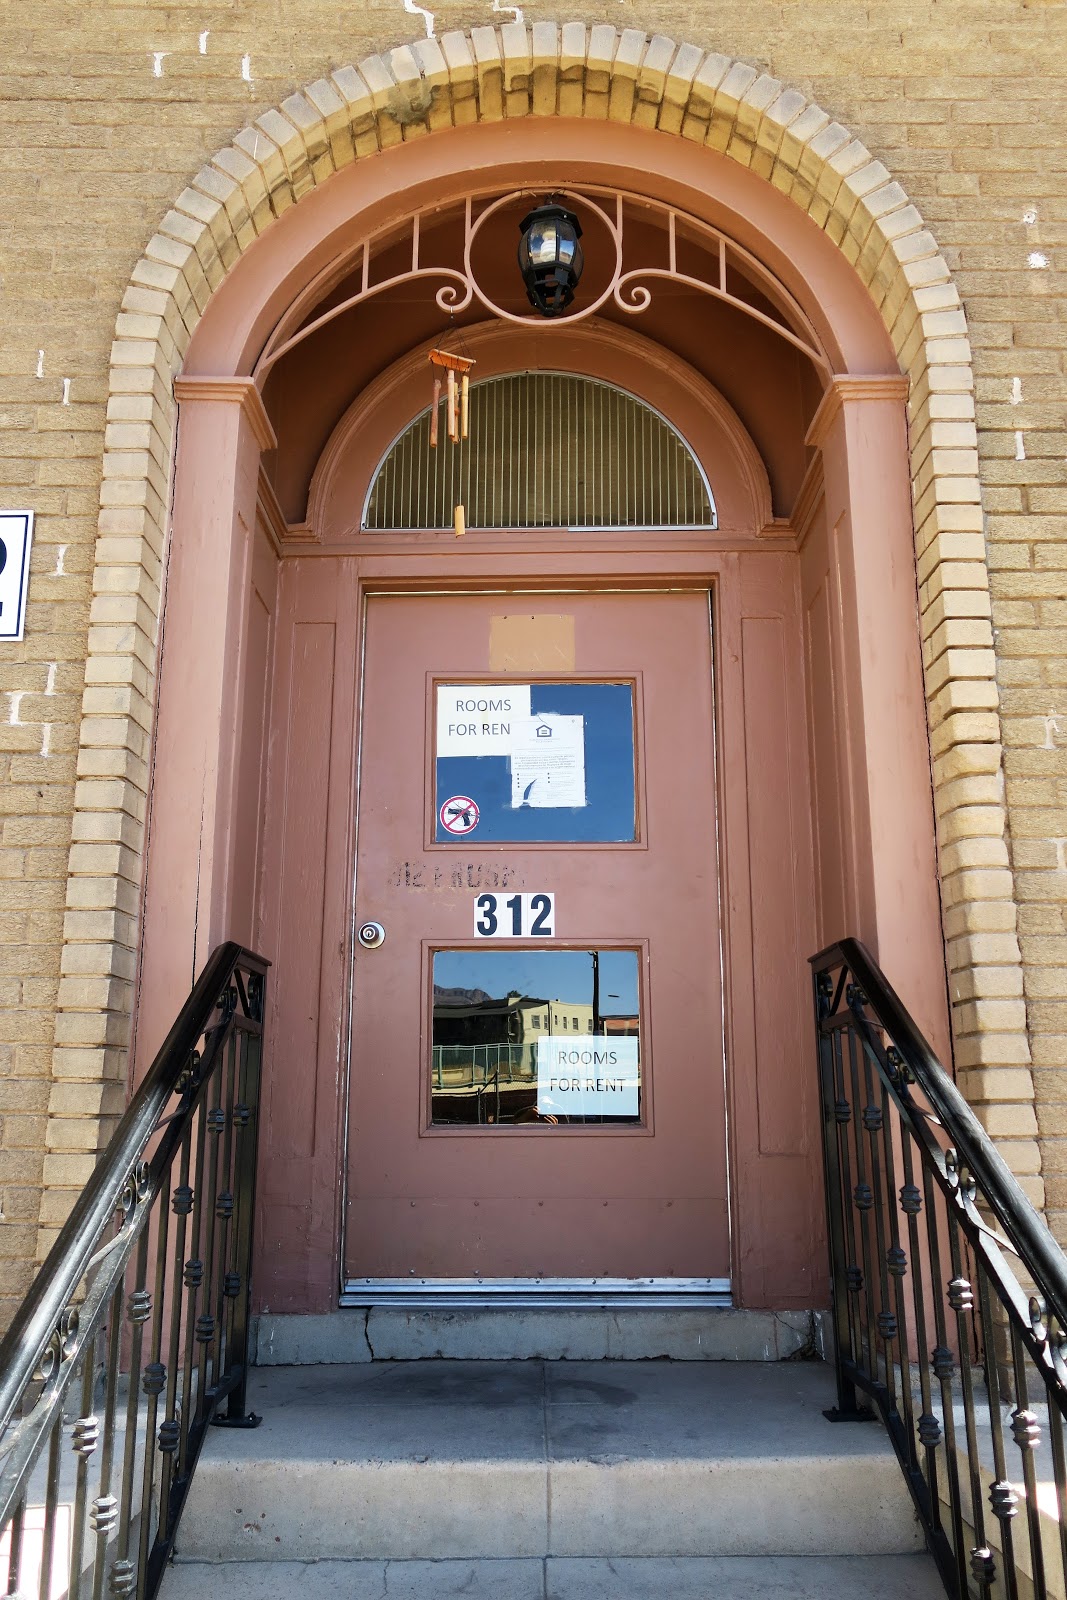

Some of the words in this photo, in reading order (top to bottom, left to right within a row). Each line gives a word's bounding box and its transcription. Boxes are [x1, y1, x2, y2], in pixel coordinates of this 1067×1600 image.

[456, 699, 512, 712] ROOMS
[448, 724, 477, 736] FOR
[482, 723, 511, 735] REN
[476, 893, 552, 936] 312
[558, 1051, 617, 1065] ROOMS
[550, 1078, 580, 1092] FOR
[586, 1078, 626, 1092] RENT
